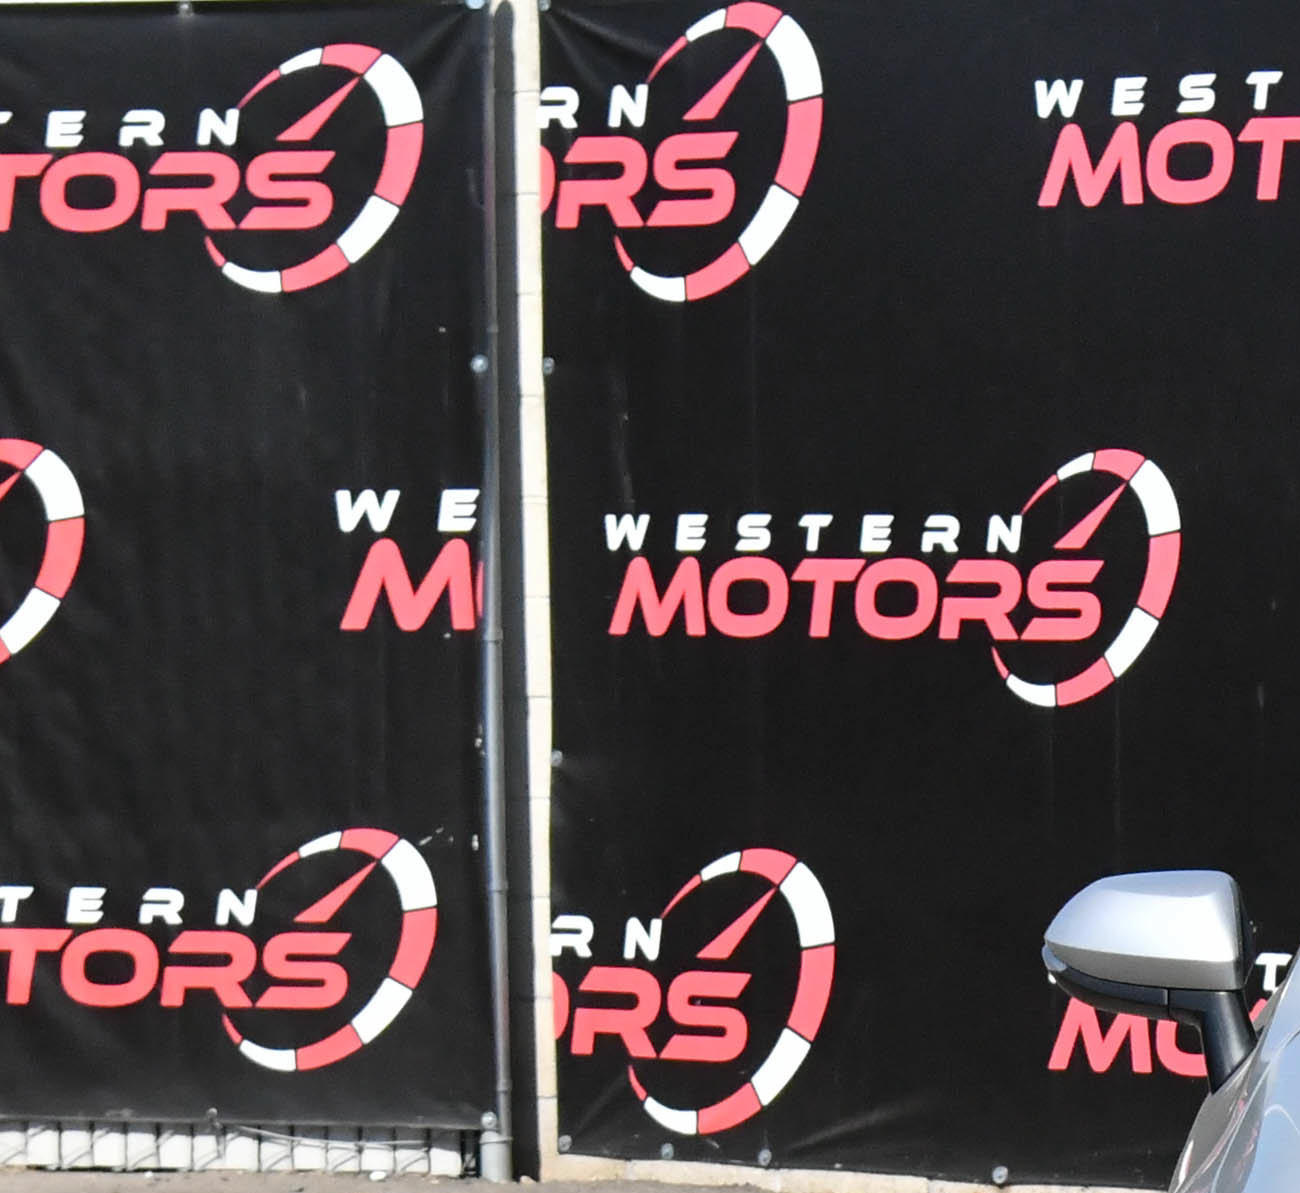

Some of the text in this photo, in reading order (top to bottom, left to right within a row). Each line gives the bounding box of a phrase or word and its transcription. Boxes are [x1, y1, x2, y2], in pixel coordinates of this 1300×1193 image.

[0, 109, 240, 148] ERN
[539, 131, 739, 230] RS
[604, 513, 1023, 554] WESTERN
[607, 555, 1105, 642] MOTORS
[552, 966, 752, 1063] RS
